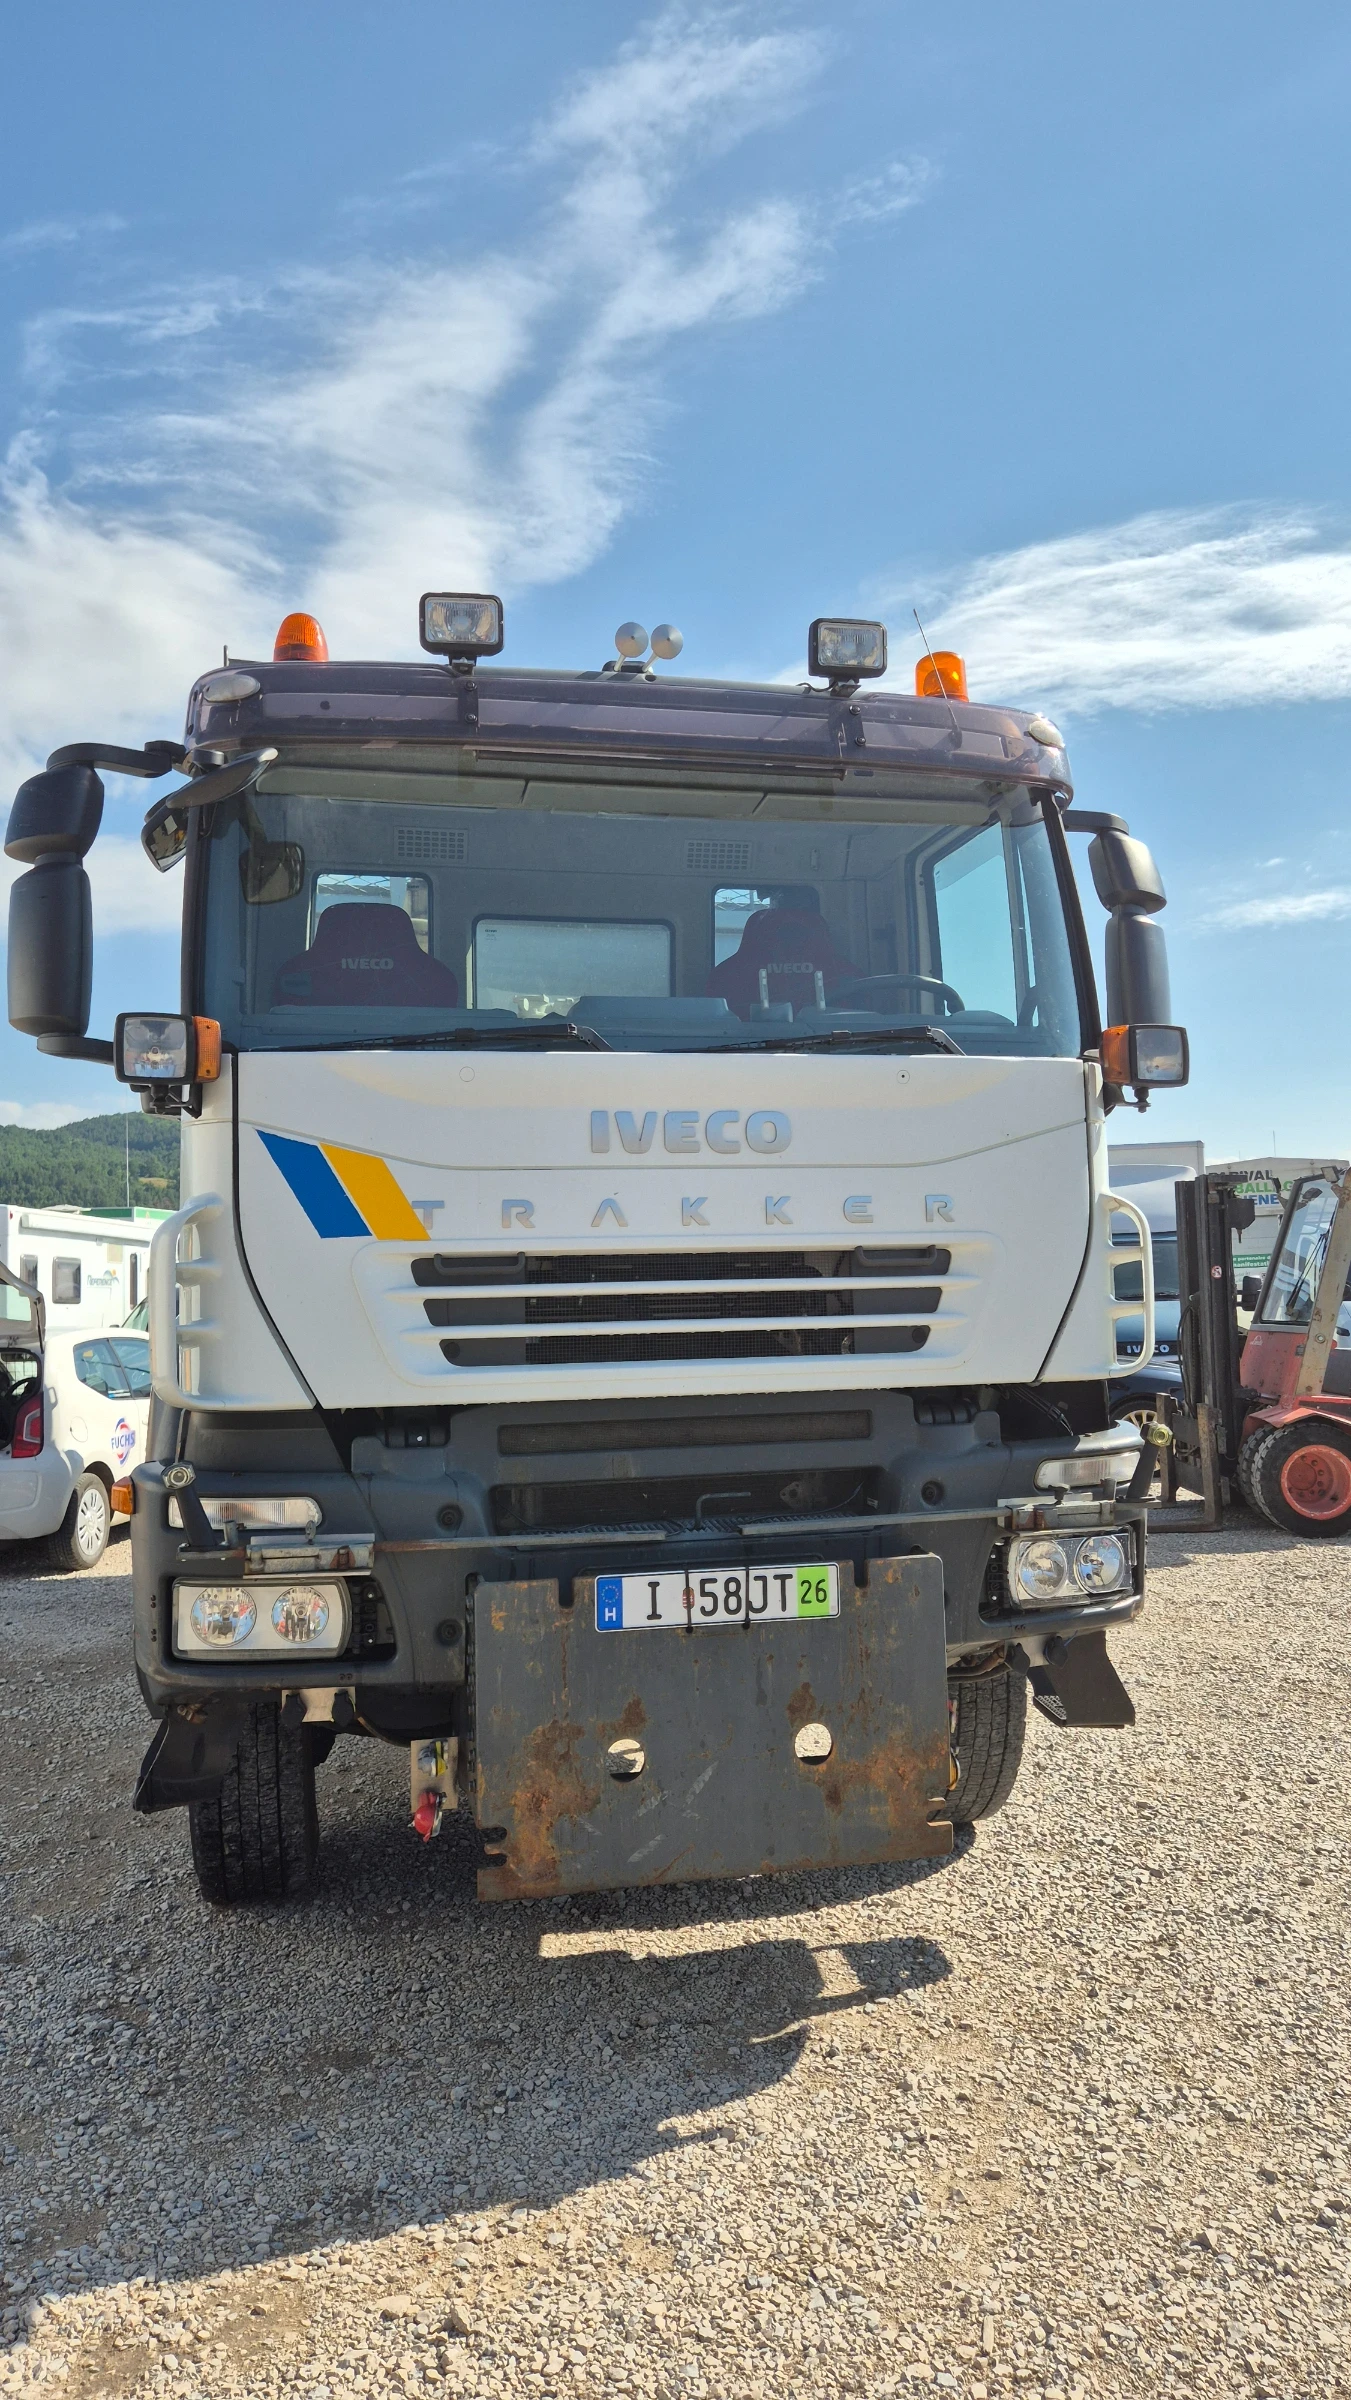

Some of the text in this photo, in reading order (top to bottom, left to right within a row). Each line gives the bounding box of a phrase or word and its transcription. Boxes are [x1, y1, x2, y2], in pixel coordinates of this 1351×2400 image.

[341, 957, 394, 970] IVECO
[767, 962, 814, 974] IVECO
[590, 1110, 793, 1154] IVECO
[412, 1193, 956, 1230] TRAKKER
[1126, 1344, 1170, 1354] IVO
[111, 1430, 136, 1450] FUCHS
[604, 1607, 617, 1622] H
[647, 1581, 663, 1620] I
[800, 1578, 828, 1605] 26
